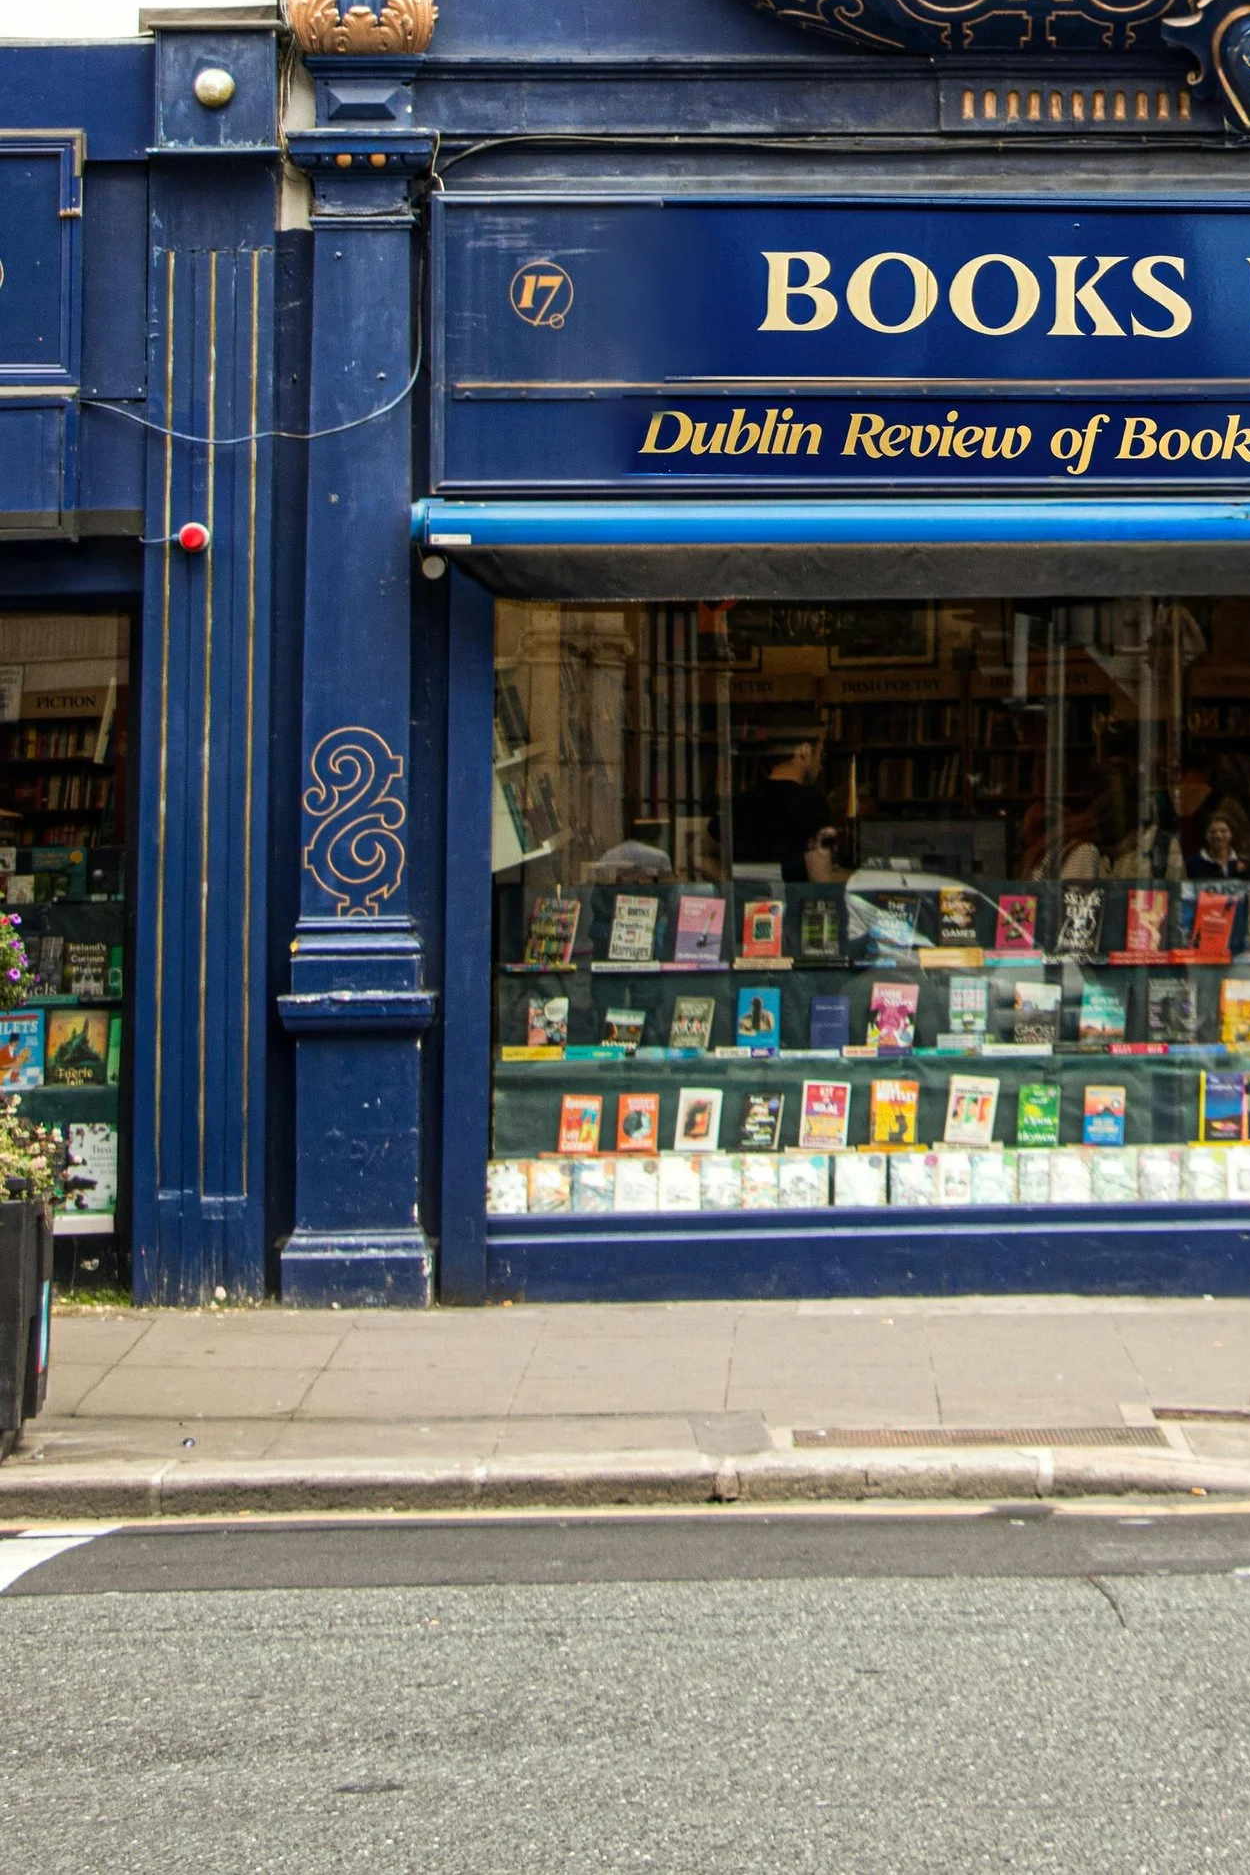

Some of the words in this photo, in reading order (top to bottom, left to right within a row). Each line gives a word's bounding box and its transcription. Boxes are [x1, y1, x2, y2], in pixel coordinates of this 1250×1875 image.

[516, 270, 565, 327] 17
[758, 251, 1193, 338] BOOKS
[639, 408, 823, 456] Dublin
[841, 410, 1031, 459] Review
[1050, 413, 1110, 474] of
[37, 694, 97, 708] FICTION
[941, 928, 977, 939] GAMES
[69, 942, 106, 952] Ireland's
[71, 954, 105, 963] Curious
[72, 965, 102, 974] Places
